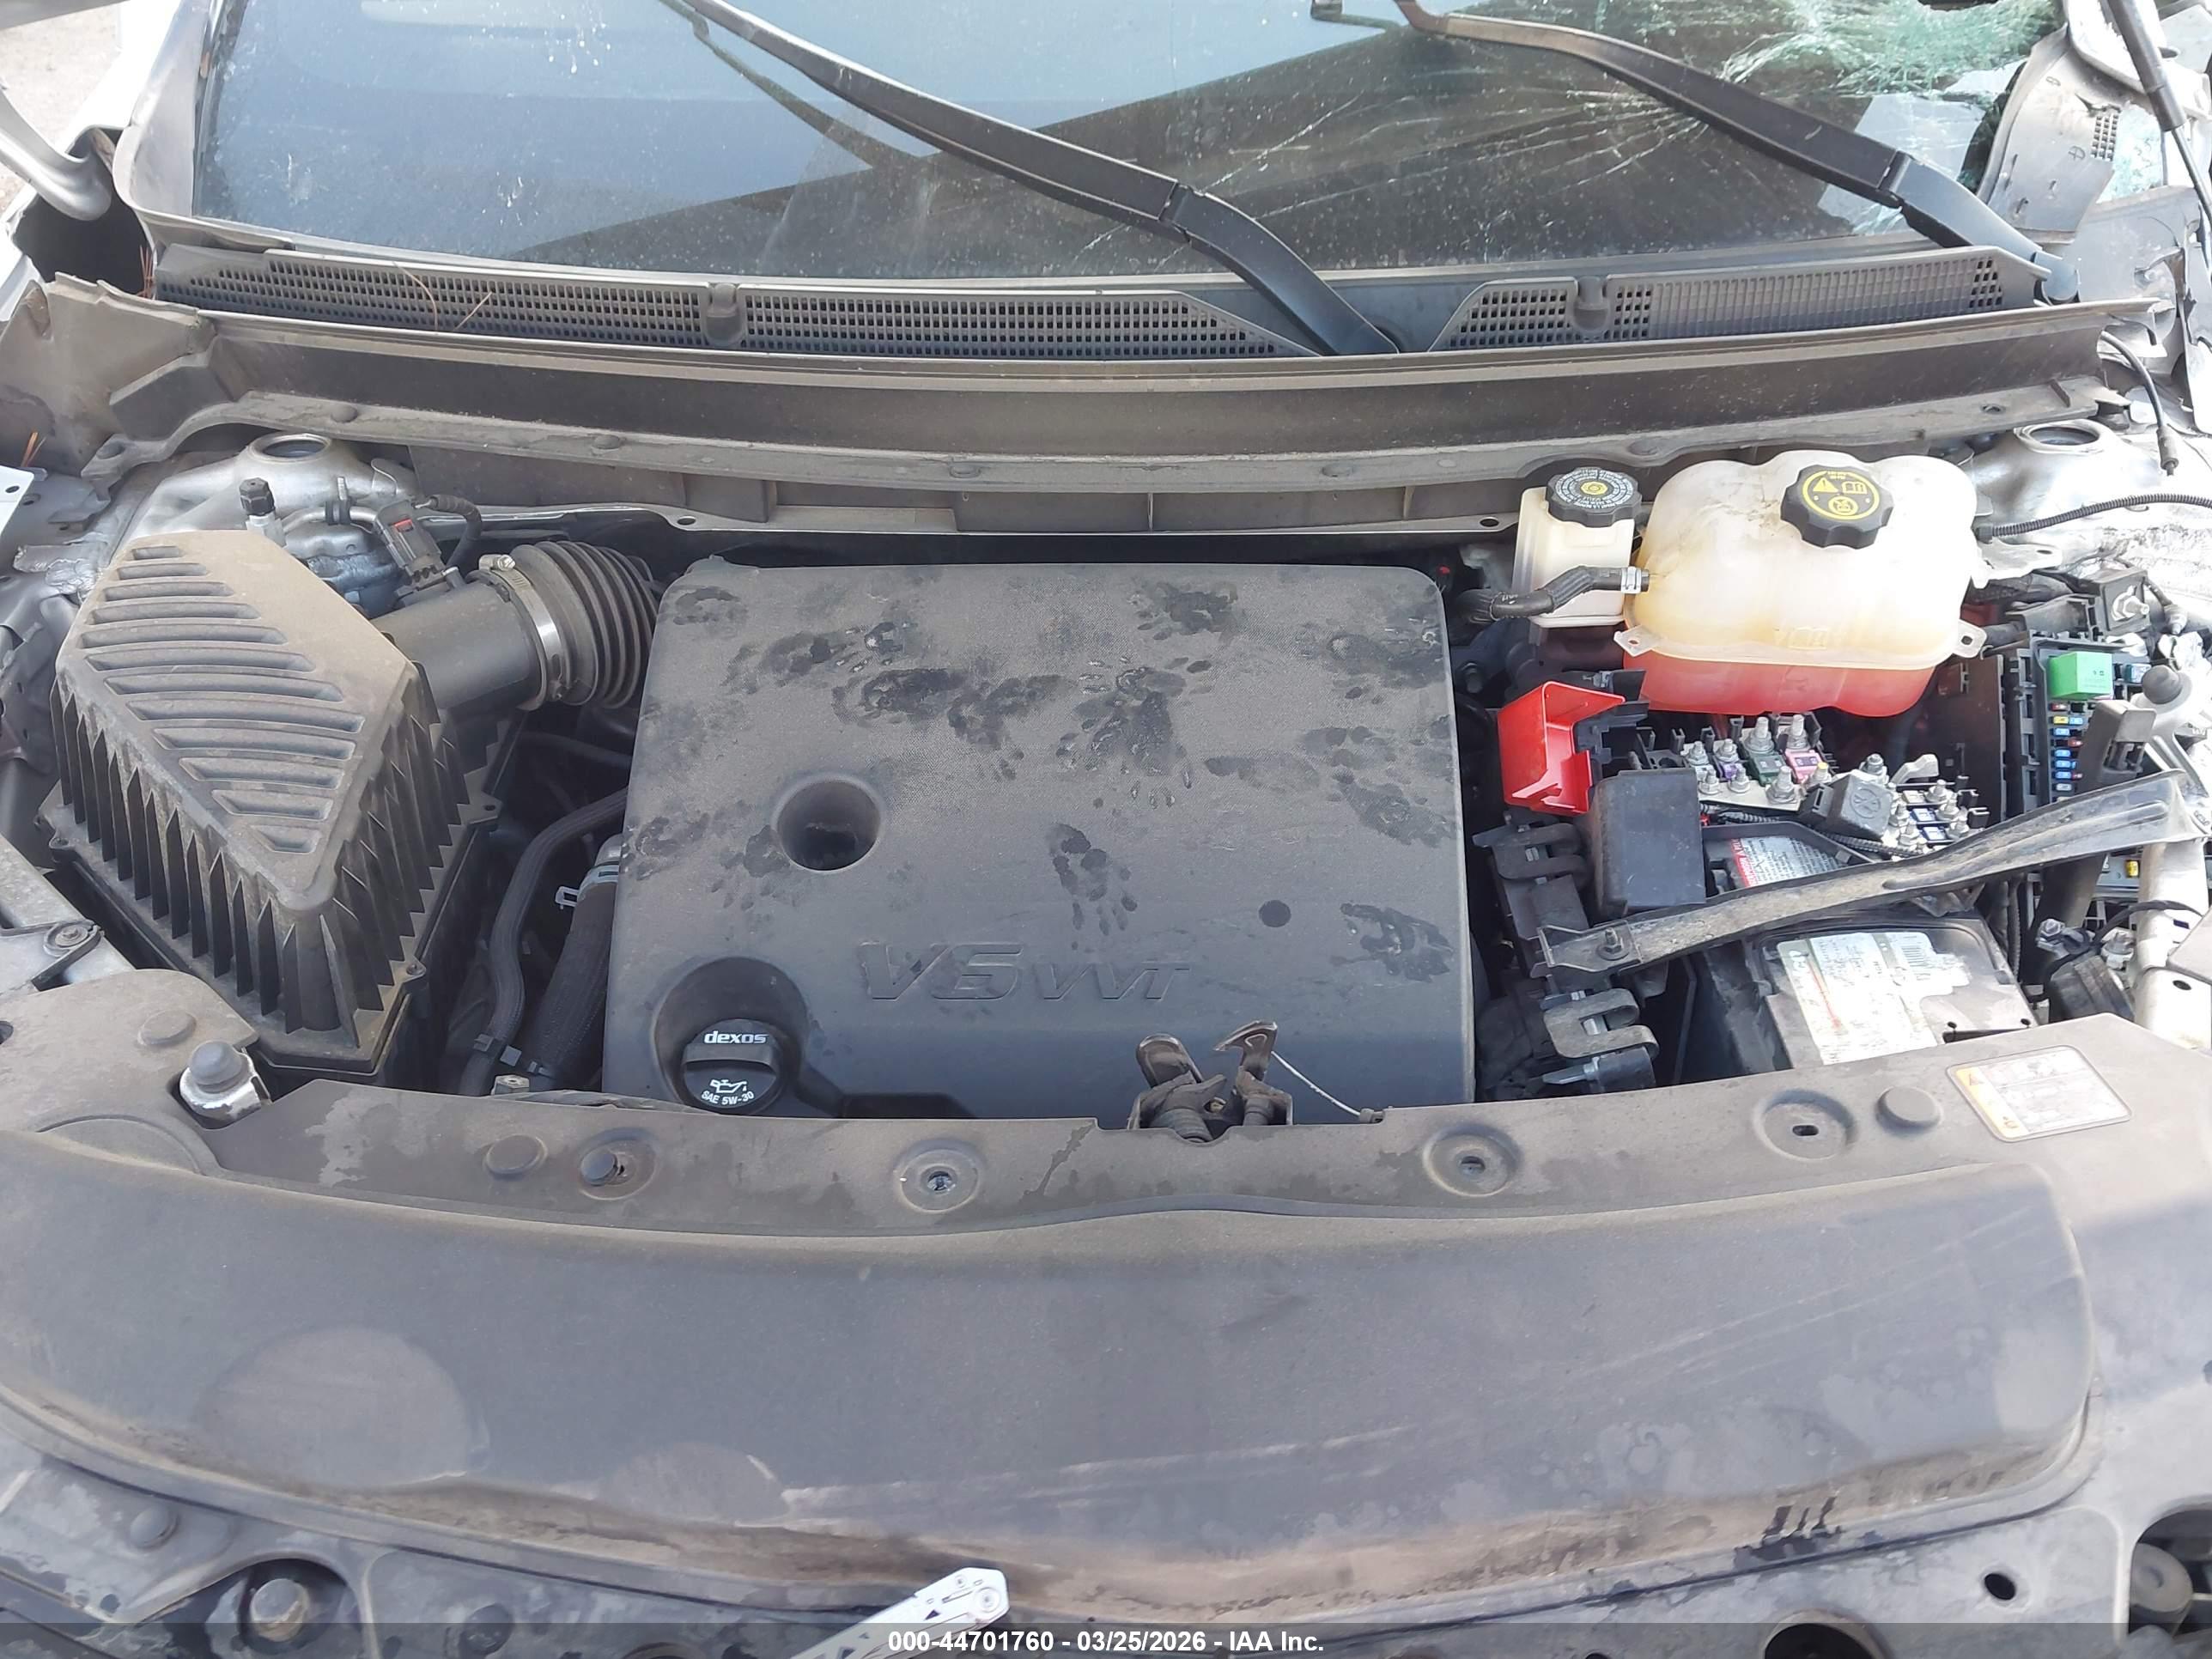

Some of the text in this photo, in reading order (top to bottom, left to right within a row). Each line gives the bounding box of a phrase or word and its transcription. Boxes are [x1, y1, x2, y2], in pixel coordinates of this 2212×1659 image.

[860, 941, 1190, 1000] V6 VVT
[703, 1030, 769, 1044] dexos
[701, 1091, 755, 1105] SAE 5W-30
